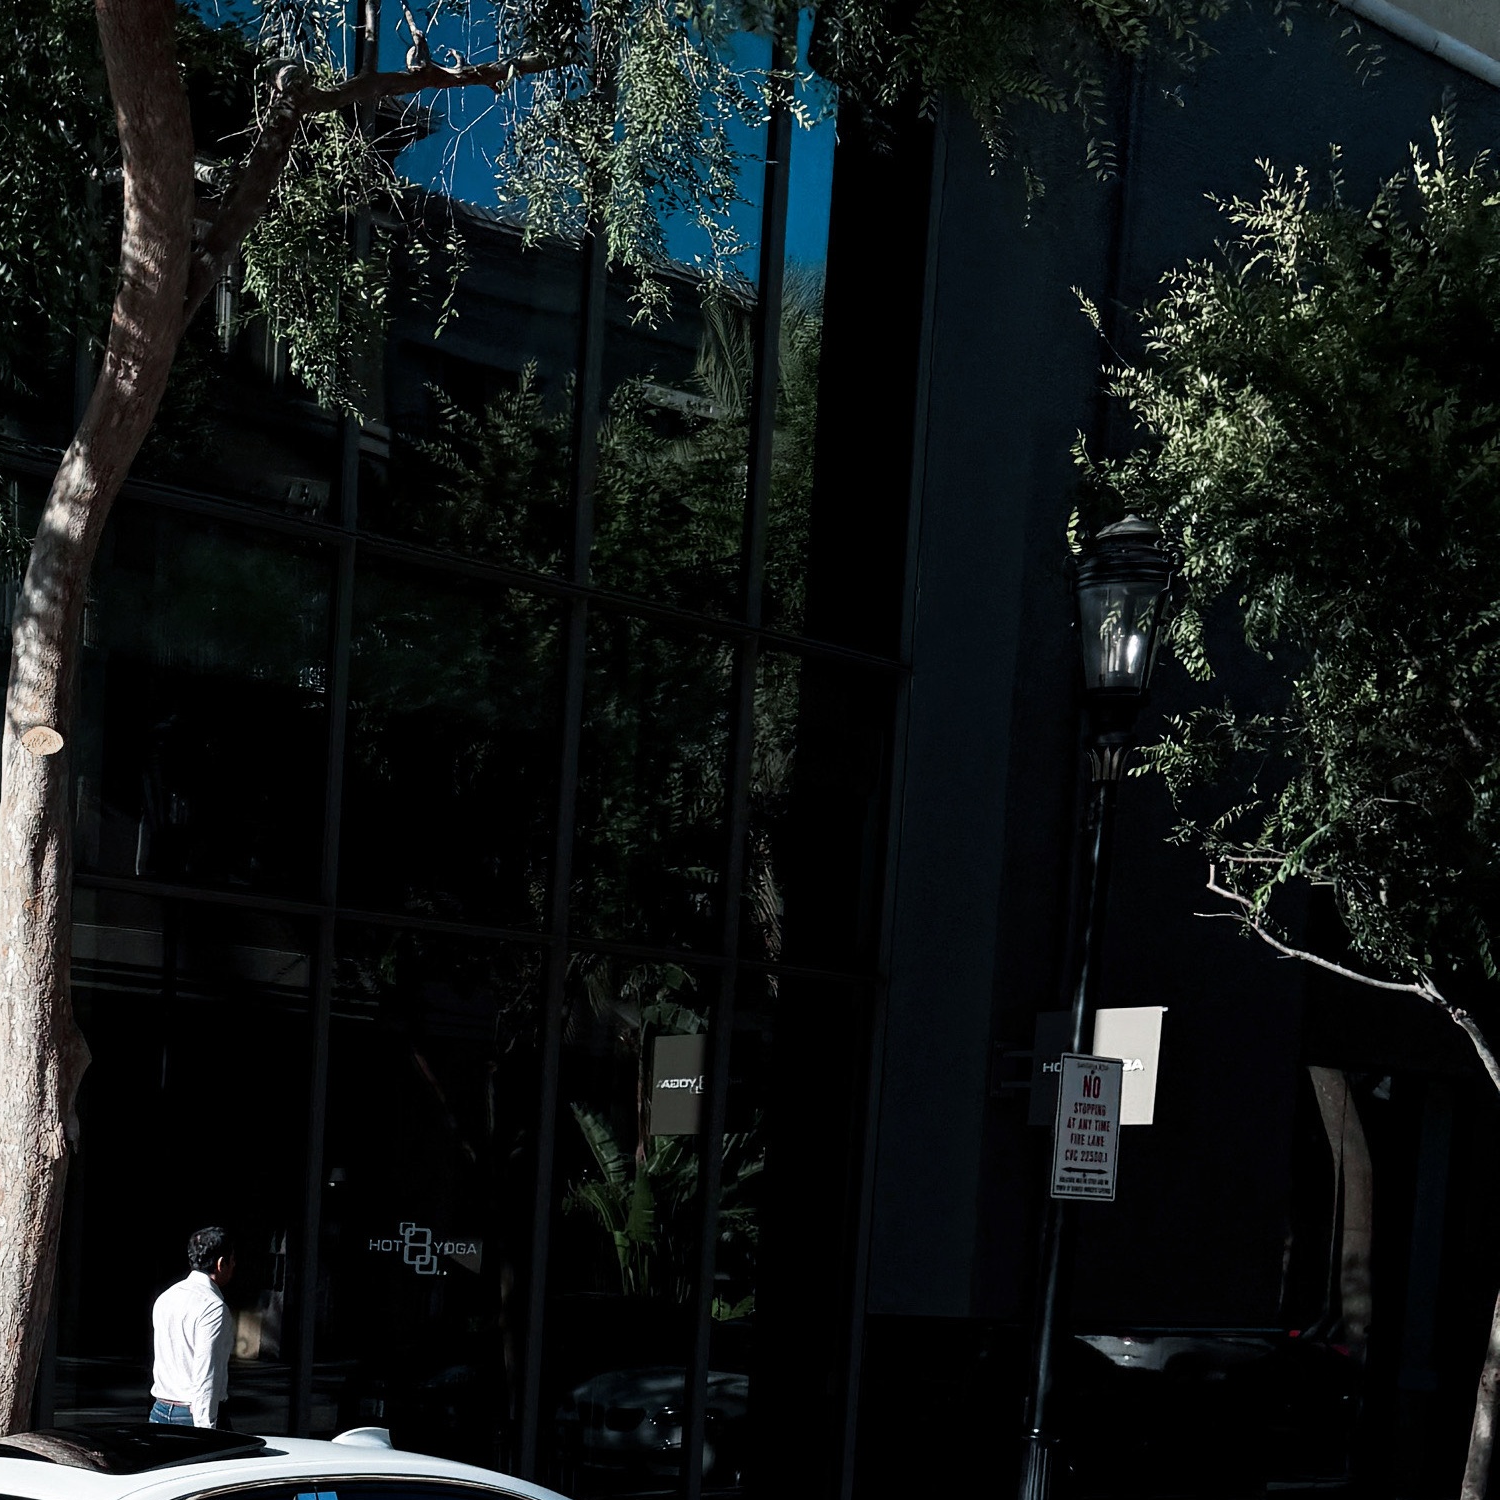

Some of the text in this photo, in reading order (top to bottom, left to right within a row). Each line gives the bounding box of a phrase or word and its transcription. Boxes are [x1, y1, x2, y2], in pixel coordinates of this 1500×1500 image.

[1043, 1063, 1062, 1073] HO
[1083, 1075, 1101, 1099] NO
[1074, 1102, 1107, 1116] STOPPING
[1067, 1117, 1110, 1132] AT ANY TIME
[1070, 1133, 1104, 1147] FIRE LANE
[1065, 1150, 1078, 1162] CVC
[369, 1239, 403, 1252] HOT
[433, 1241, 477, 1255] YOGA
